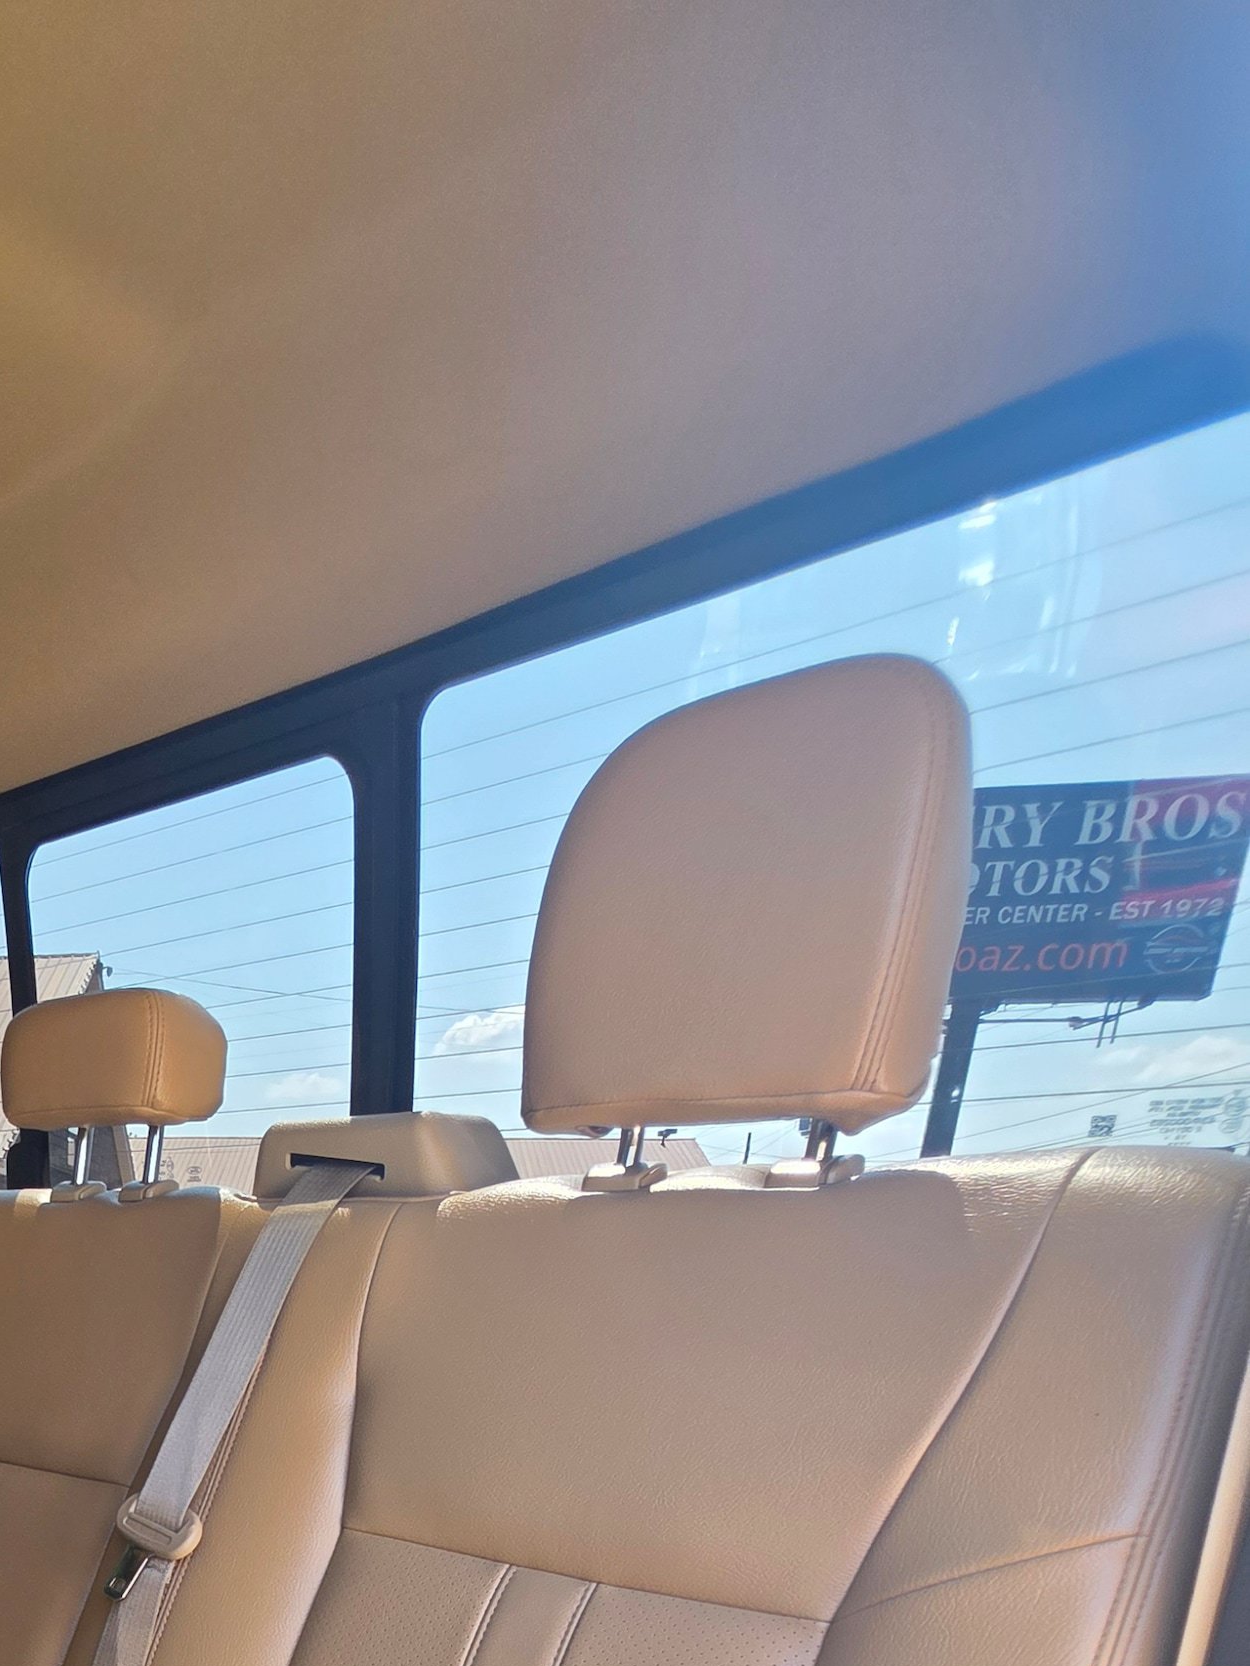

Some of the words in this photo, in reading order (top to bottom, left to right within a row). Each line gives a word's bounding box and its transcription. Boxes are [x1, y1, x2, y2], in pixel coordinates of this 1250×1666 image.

[972, 800, 1064, 850] RY
[1074, 790, 1247, 846] BROS
[997, 903, 1088, 925] CENTER
[1110, 900, 1152, 920] EST
[1160, 898, 1224, 919] 1972
